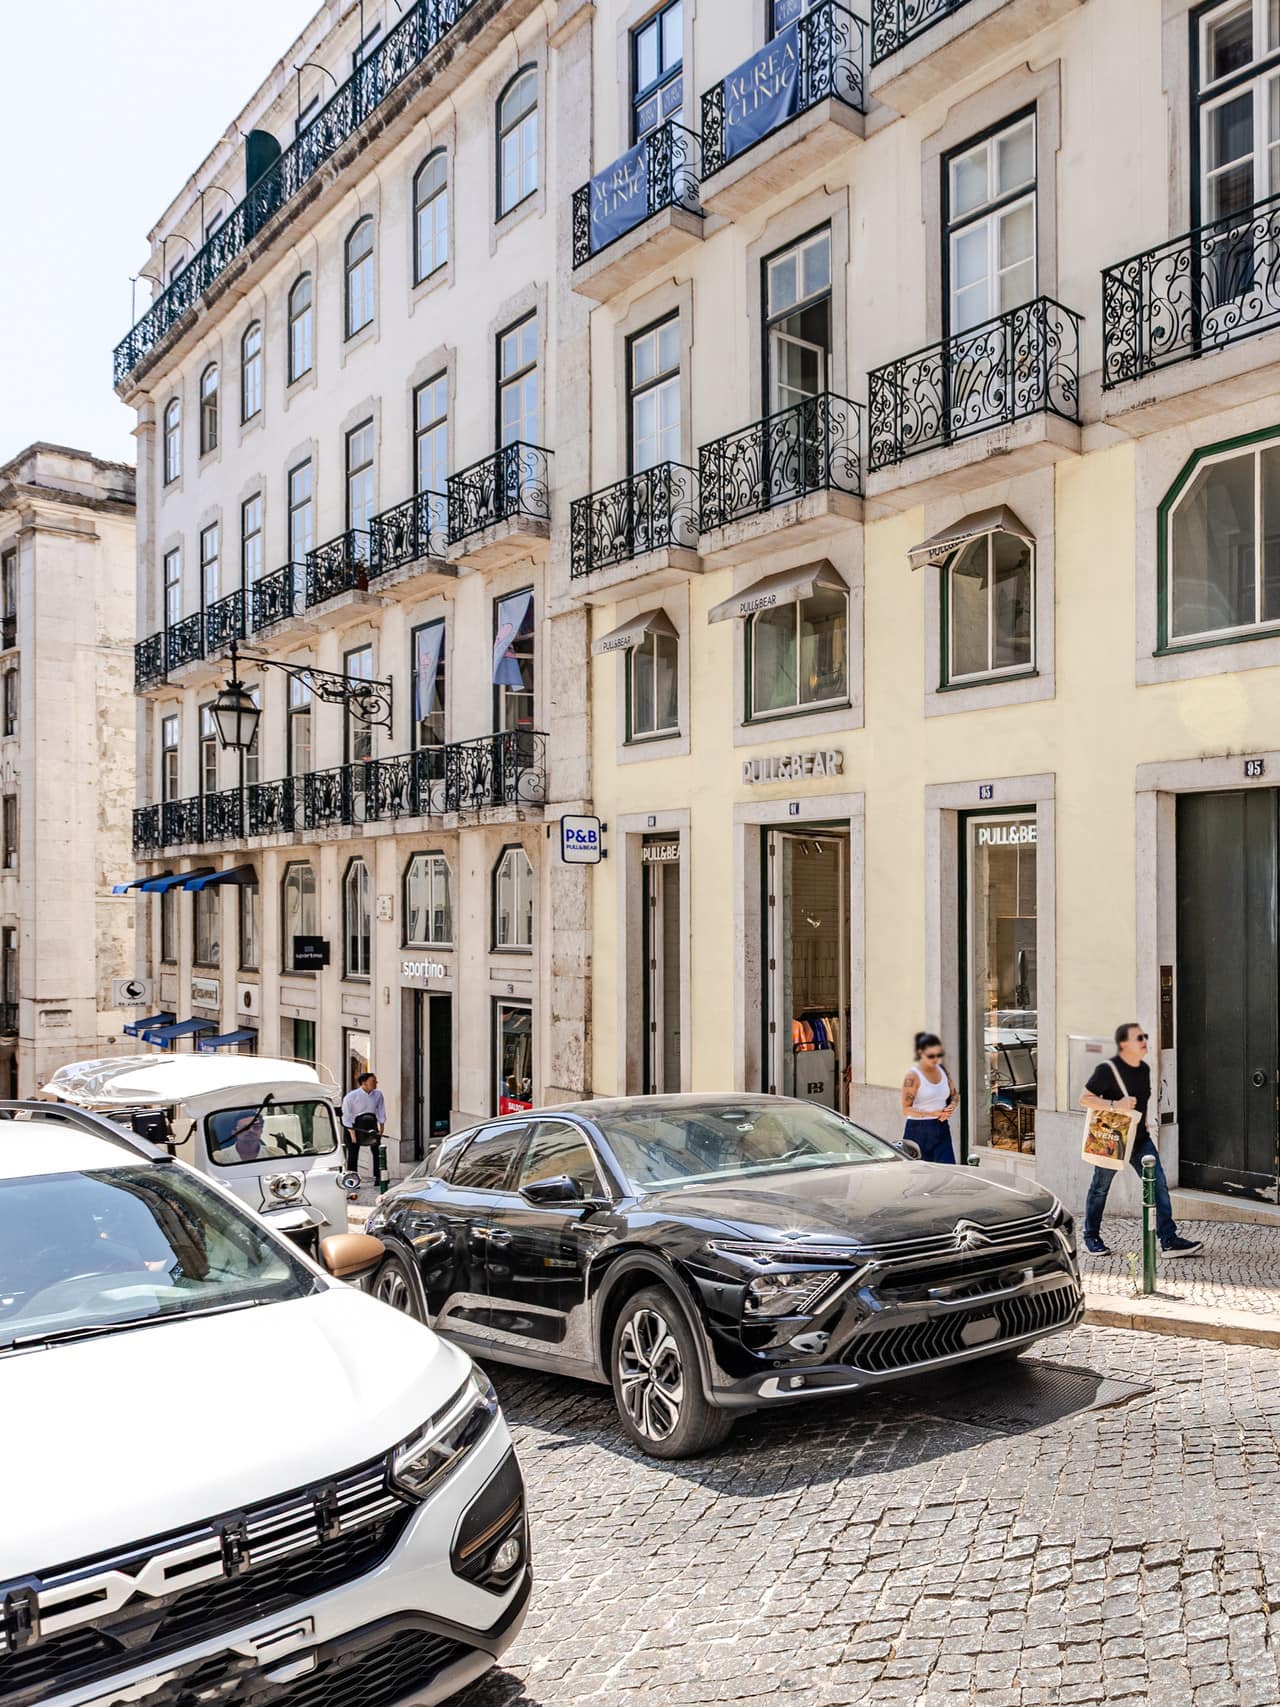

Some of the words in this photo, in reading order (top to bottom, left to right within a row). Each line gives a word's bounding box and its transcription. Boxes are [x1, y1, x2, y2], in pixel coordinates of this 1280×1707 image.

[729, 43, 795, 108] AUREA
[728, 63, 795, 126] CLINIC
[740, 594, 777, 612] PULL&BEAR
[742, 751, 843, 785] PULL&BEAR
[1247, 760, 1261, 776] 95
[566, 829, 598, 843] P&B
[403, 957, 444, 979] sportino
